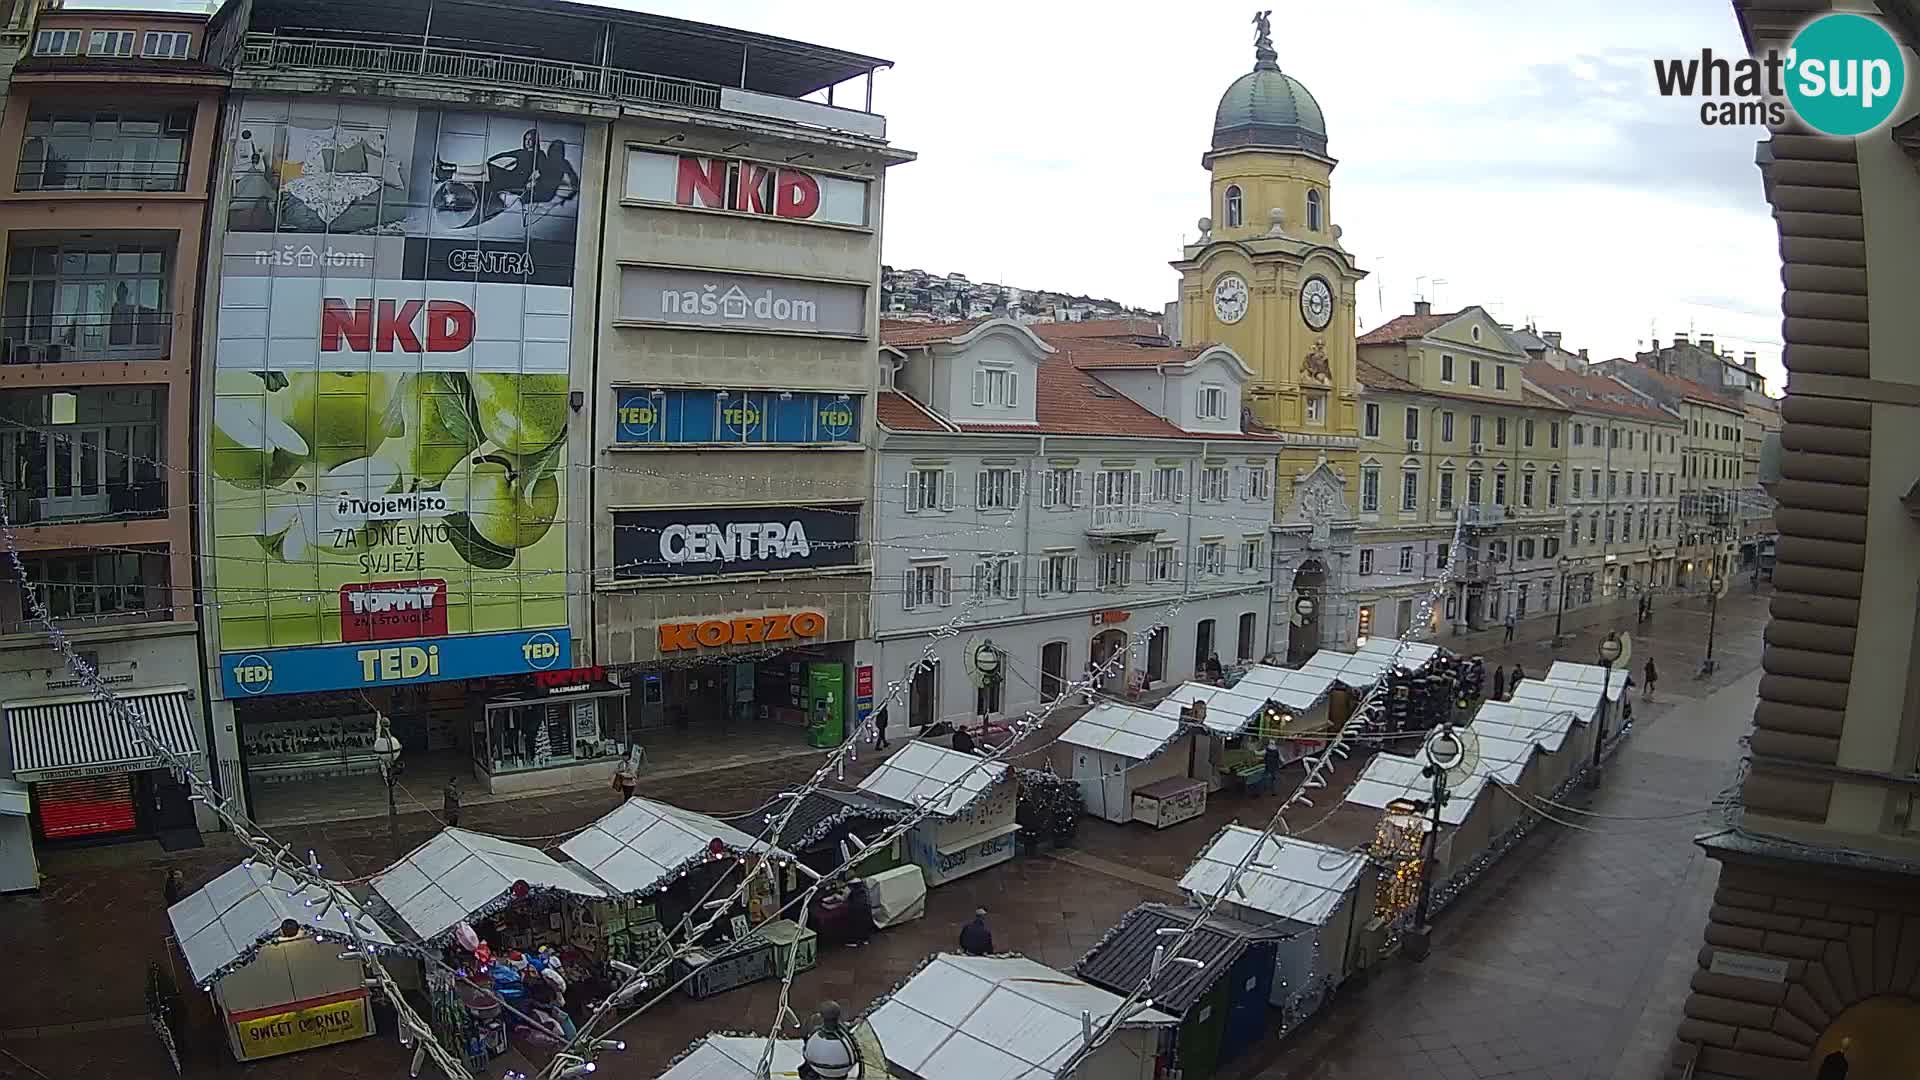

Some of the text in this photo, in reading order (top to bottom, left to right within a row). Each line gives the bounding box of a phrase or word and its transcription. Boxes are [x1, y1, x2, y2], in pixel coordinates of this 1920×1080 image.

[676, 157, 820, 220] NKD
[254, 244, 366, 269] naš dom
[447, 248, 536, 276] CENTRA
[661, 283, 817, 323] naš dom
[320, 297, 476, 355] NKD
[618, 406, 657, 425] TEDi
[723, 408, 760, 426] TEDi
[819, 409, 853, 427] TEDi
[338, 494, 446, 518] #TvojeMisto
[333, 522, 450, 550] ZA DNEVNO
[659, 521, 811, 563] CENTRA
[360, 547, 426, 575] SVJEŽE
[348, 584, 439, 615] TOMMY
[659, 613, 826, 653] KORZO
[357, 645, 439, 682] TEDi
[521, 639, 560, 661] TEDi
[233, 664, 273, 687] TEDi
[250, 1021, 292, 1041] SWEET
